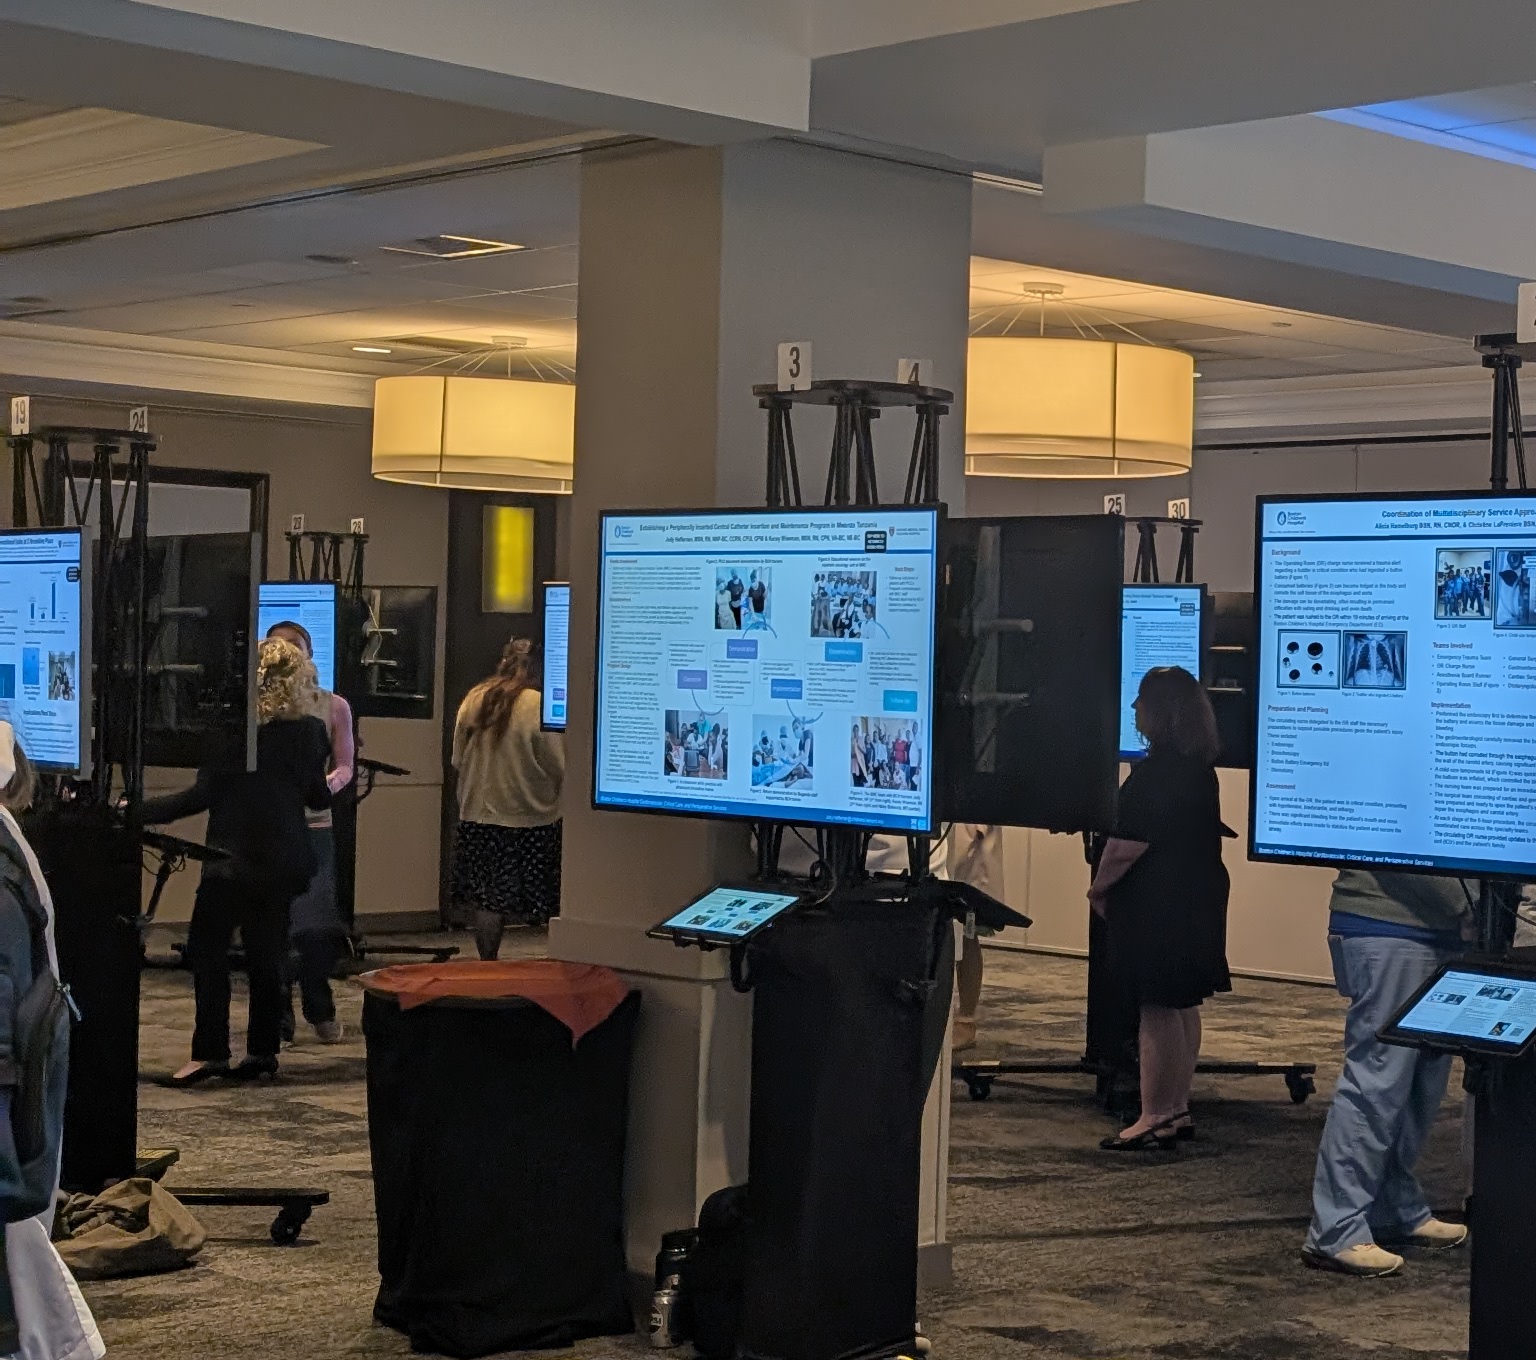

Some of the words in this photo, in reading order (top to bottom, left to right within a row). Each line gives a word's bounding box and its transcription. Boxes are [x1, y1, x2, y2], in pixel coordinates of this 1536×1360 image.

[789, 347, 800, 378] 3
[908, 363, 920, 386] 4
[15, 400, 26, 424] 19
[133, 411, 146, 432] 24
[1108, 497, 1122, 515] 25
[1172, 502, 1186, 519] 30
[1424, 509, 1431, 517] of
[1432, 509, 1486, 517] Multidisciplinary
[1487, 508, 1513, 516] Service
